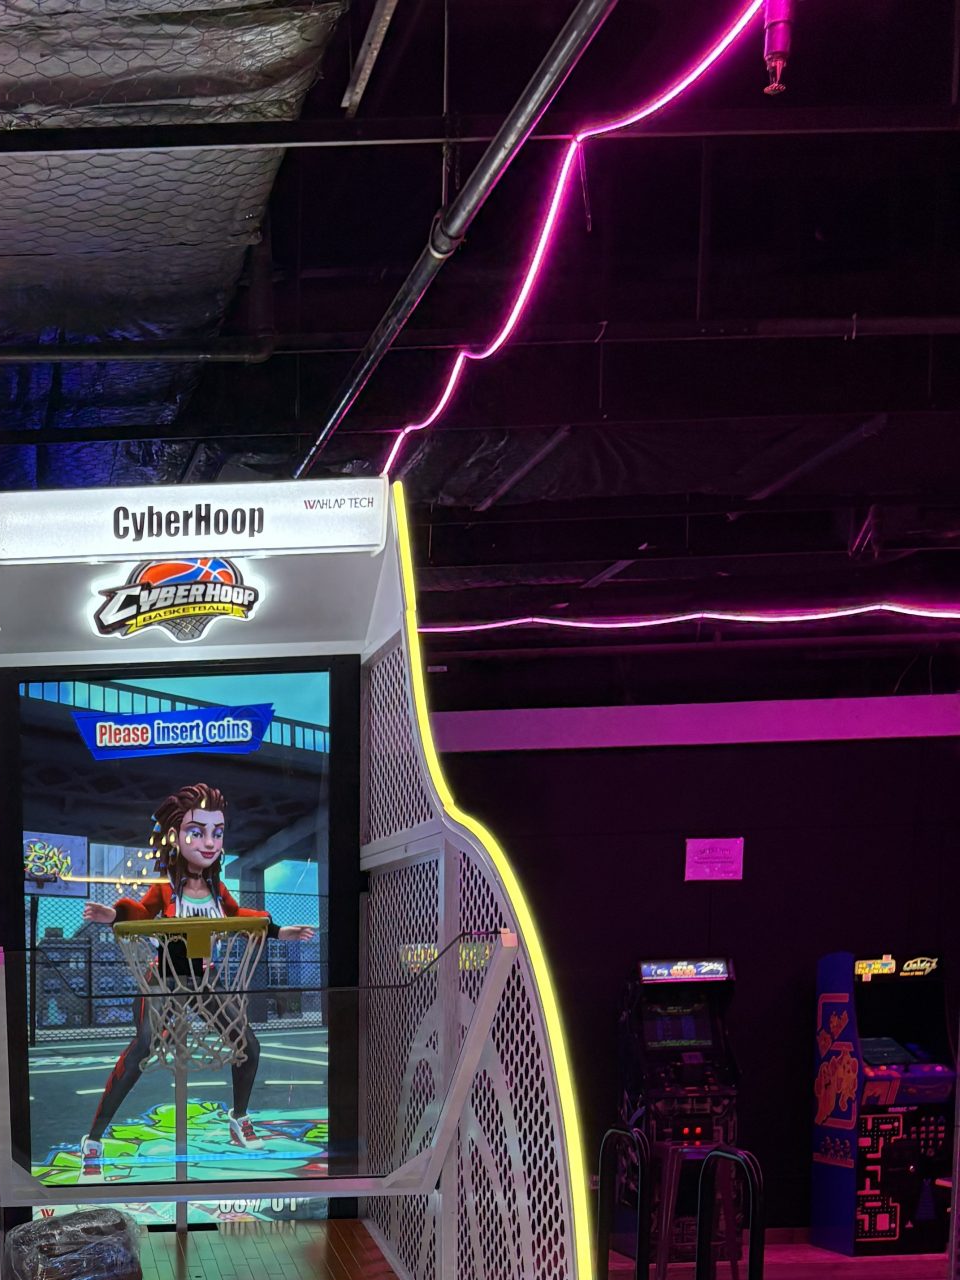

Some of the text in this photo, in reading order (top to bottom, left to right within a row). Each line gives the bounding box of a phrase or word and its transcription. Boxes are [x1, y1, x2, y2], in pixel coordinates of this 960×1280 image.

[304, 496, 374, 510] WAHLAP TECH
[112, 501, 265, 541] CyberHoop
[142, 604, 230, 625] BASKETBALL
[96, 719, 252, 746] Please insert coins
